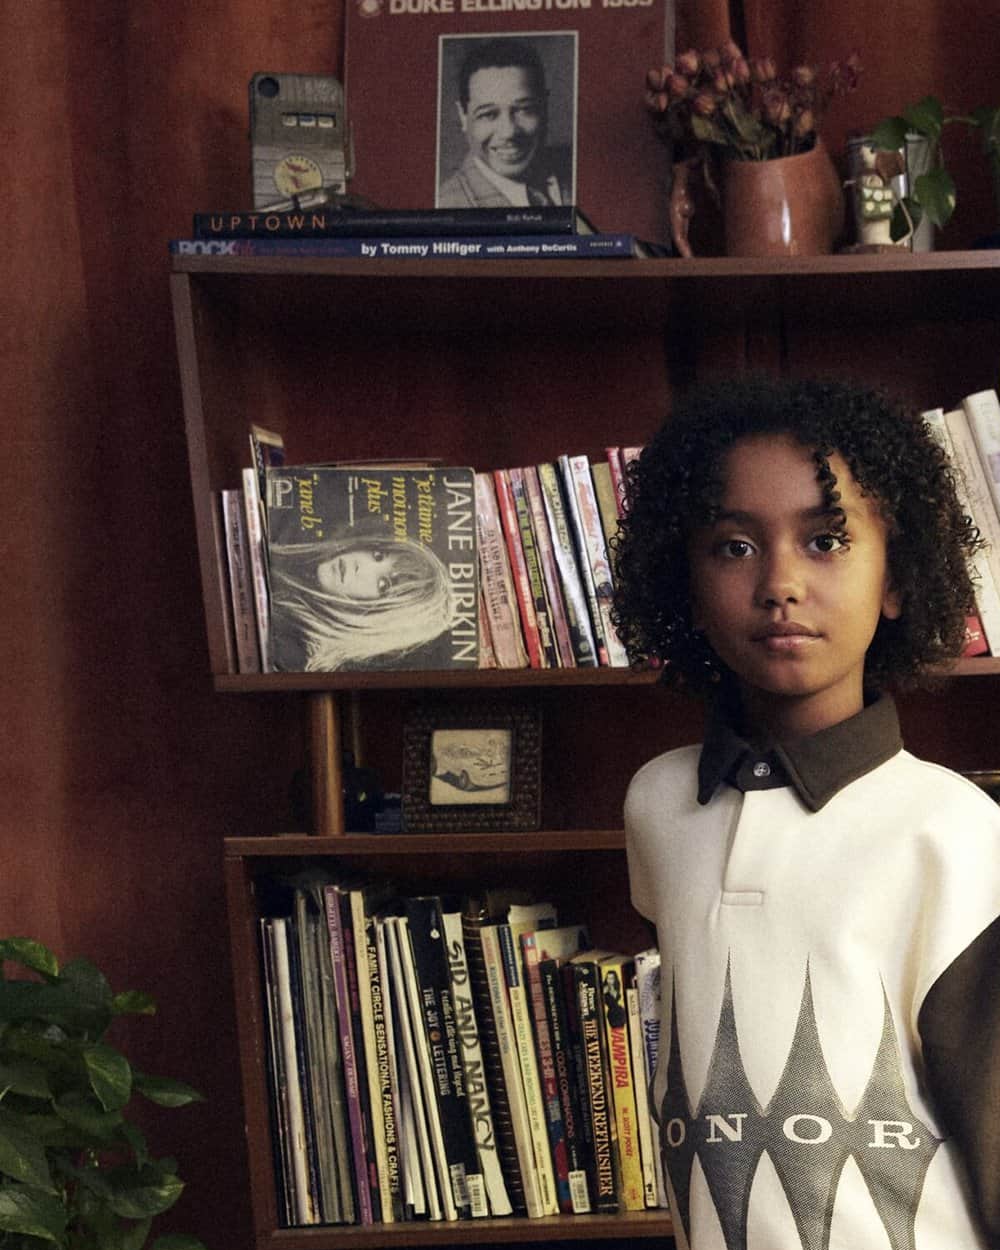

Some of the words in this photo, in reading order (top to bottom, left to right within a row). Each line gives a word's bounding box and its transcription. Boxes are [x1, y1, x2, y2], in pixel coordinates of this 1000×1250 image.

[389, 0, 455, 14] DUKE
[461, 0, 591, 12] ELLINGTON
[211, 215, 326, 232] UPTOWN
[361, 243, 377, 256] by
[381, 243, 429, 256] Tommy
[433, 242, 481, 255] Hilfiger
[507, 244, 539, 254] Anthony
[391, 474, 411, 510] moi
[392, 510, 408, 543] non
[443, 477, 474, 551] JANE
[448, 561, 477, 661] BIRKIN
[367, 946, 379, 984] FAMILY
[446, 940, 467, 986] SID
[371, 985, 382, 1022] CIRCLE
[423, 987, 435, 1007] THE
[578, 981, 591, 1017] Johnson
[587, 987, 599, 1010] Bruce
[426, 1008, 439, 1028] JOY
[456, 994, 478, 1049] AND
[585, 1019, 596, 1039] THE
[374, 1023, 390, 1091] SENSATIONAL
[432, 1044, 451, 1096] LETTERING
[556, 1049, 567, 1077] COLOR
[588, 1040, 606, 1110] WEEKEND
[611, 1026, 629, 1088] VAMPIRA
[382, 1094, 394, 1142] FASHIONS
[465, 1059, 495, 1151] NANCY
[559, 1077, 576, 1138] COMBINATIONS
[621, 1116, 631, 1135] SCOTT
[387, 1145, 395, 1153] &
[593, 1111, 614, 1196] REFINISHER
[388, 1154, 399, 1192] CRAFTS
